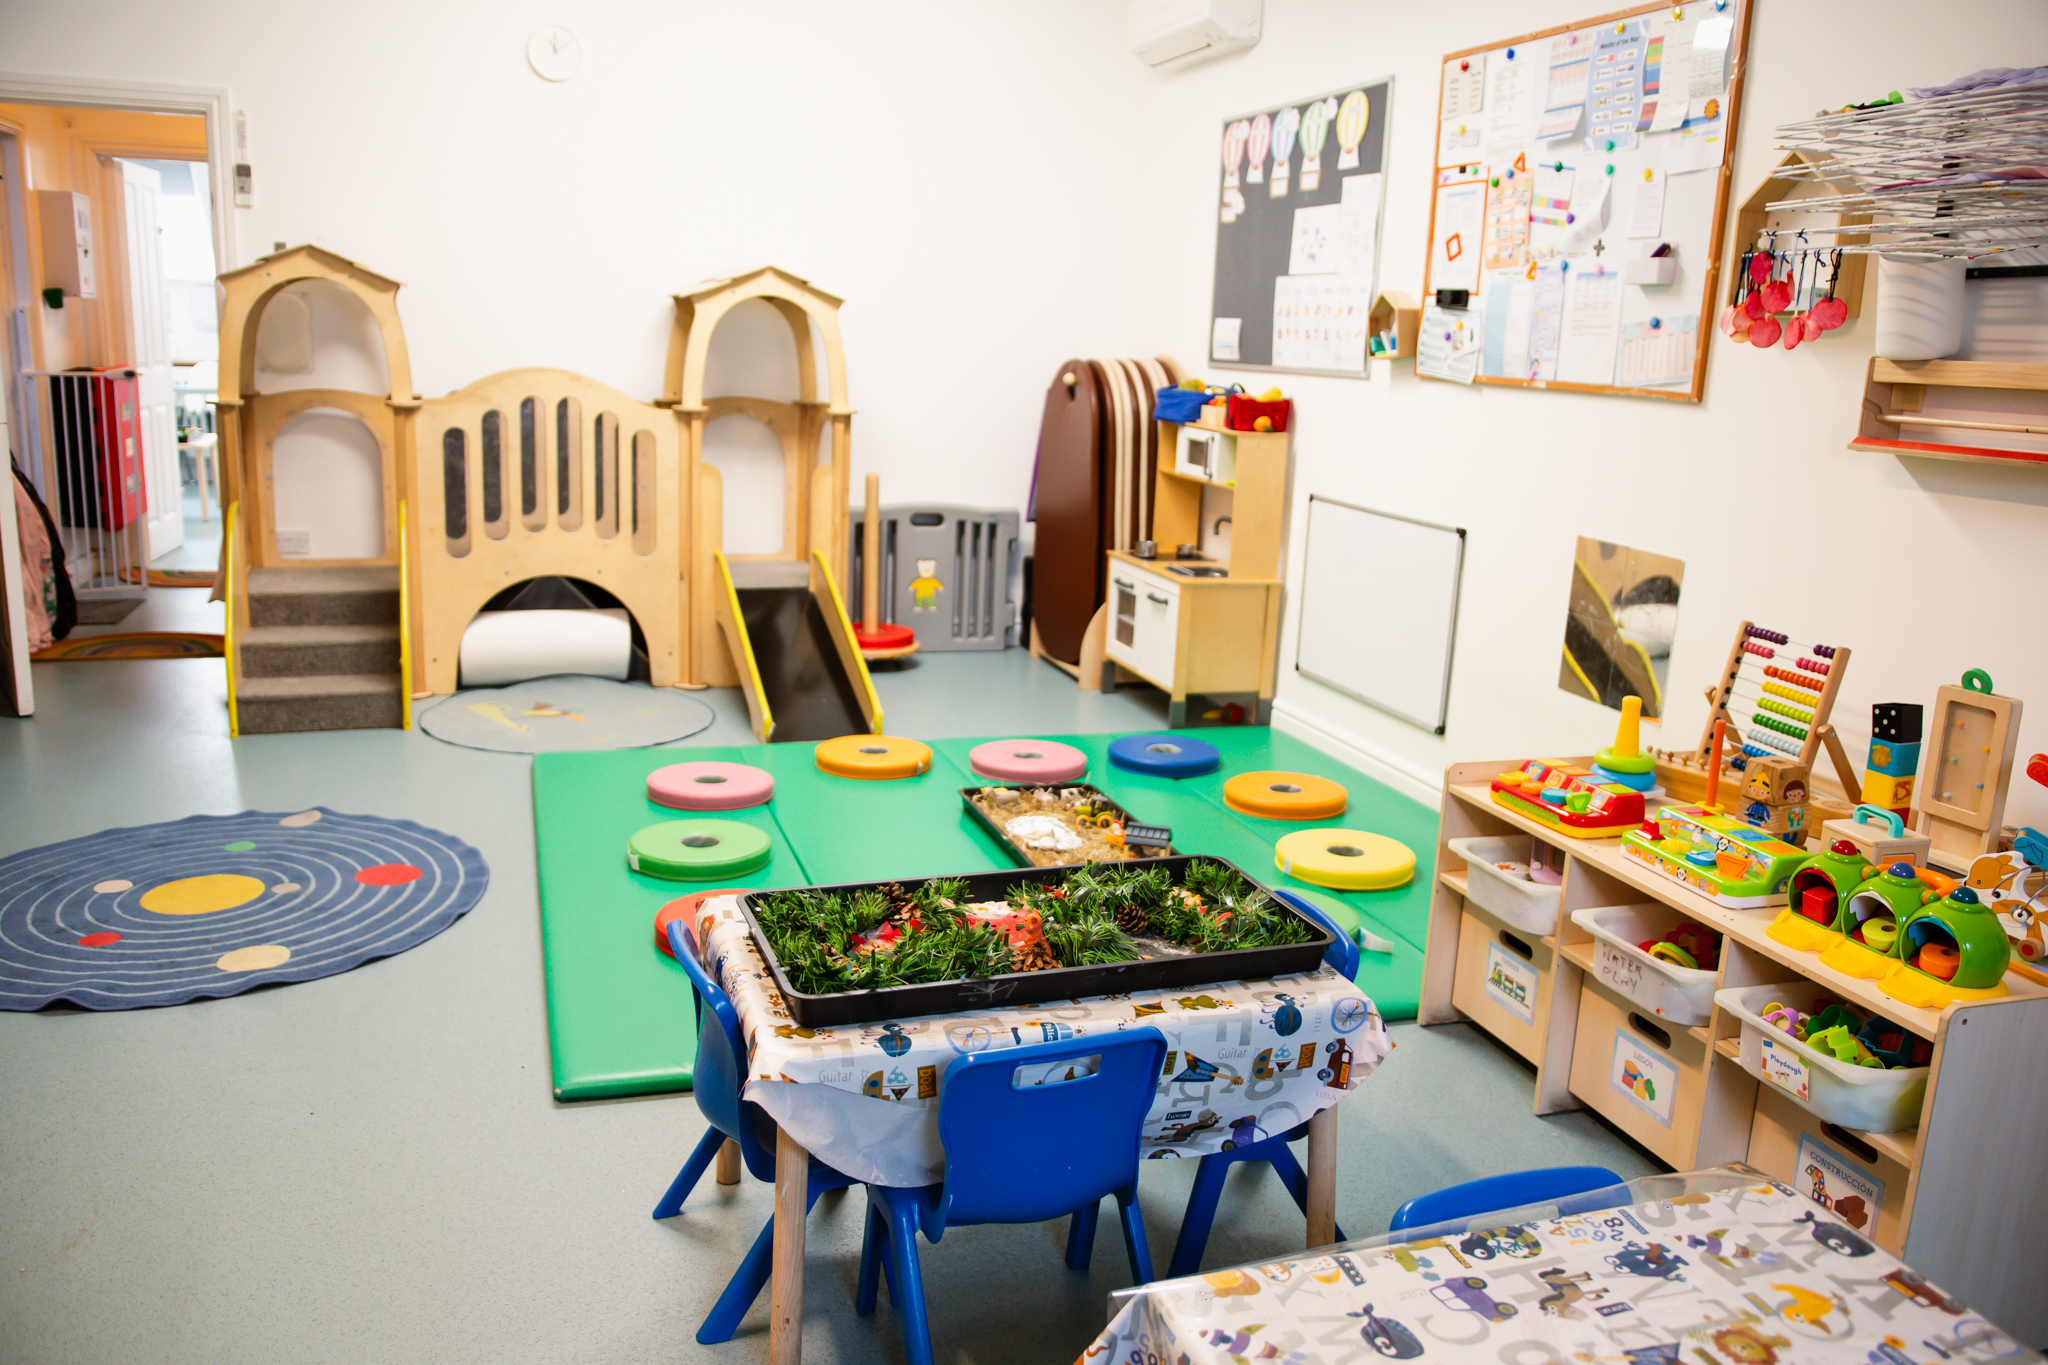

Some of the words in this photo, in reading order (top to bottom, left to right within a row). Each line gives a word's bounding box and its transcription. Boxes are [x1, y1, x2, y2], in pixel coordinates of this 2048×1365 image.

[1044, 1023, 1054, 1042] Polic
[1218, 1048, 1247, 1060] Guitar
[1299, 1045, 1315, 1068] boat
[1633, 1051, 1654, 1069] LEGOS
[1164, 1052, 1177, 1073] lion
[1770, 1053, 1802, 1075] Playdough
[818, 1070, 854, 1083] Guitar
[919, 1067, 934, 1098] boat
[1167, 1111, 1191, 1120] horse
[1810, 1151, 1874, 1198] CONSTRUCCIÓN
[1549, 1225, 1565, 1236] 4
[1603, 1217, 1624, 1228] 8
[1610, 1229, 1624, 1241] 2
[1399, 1287, 1427, 1301] car
